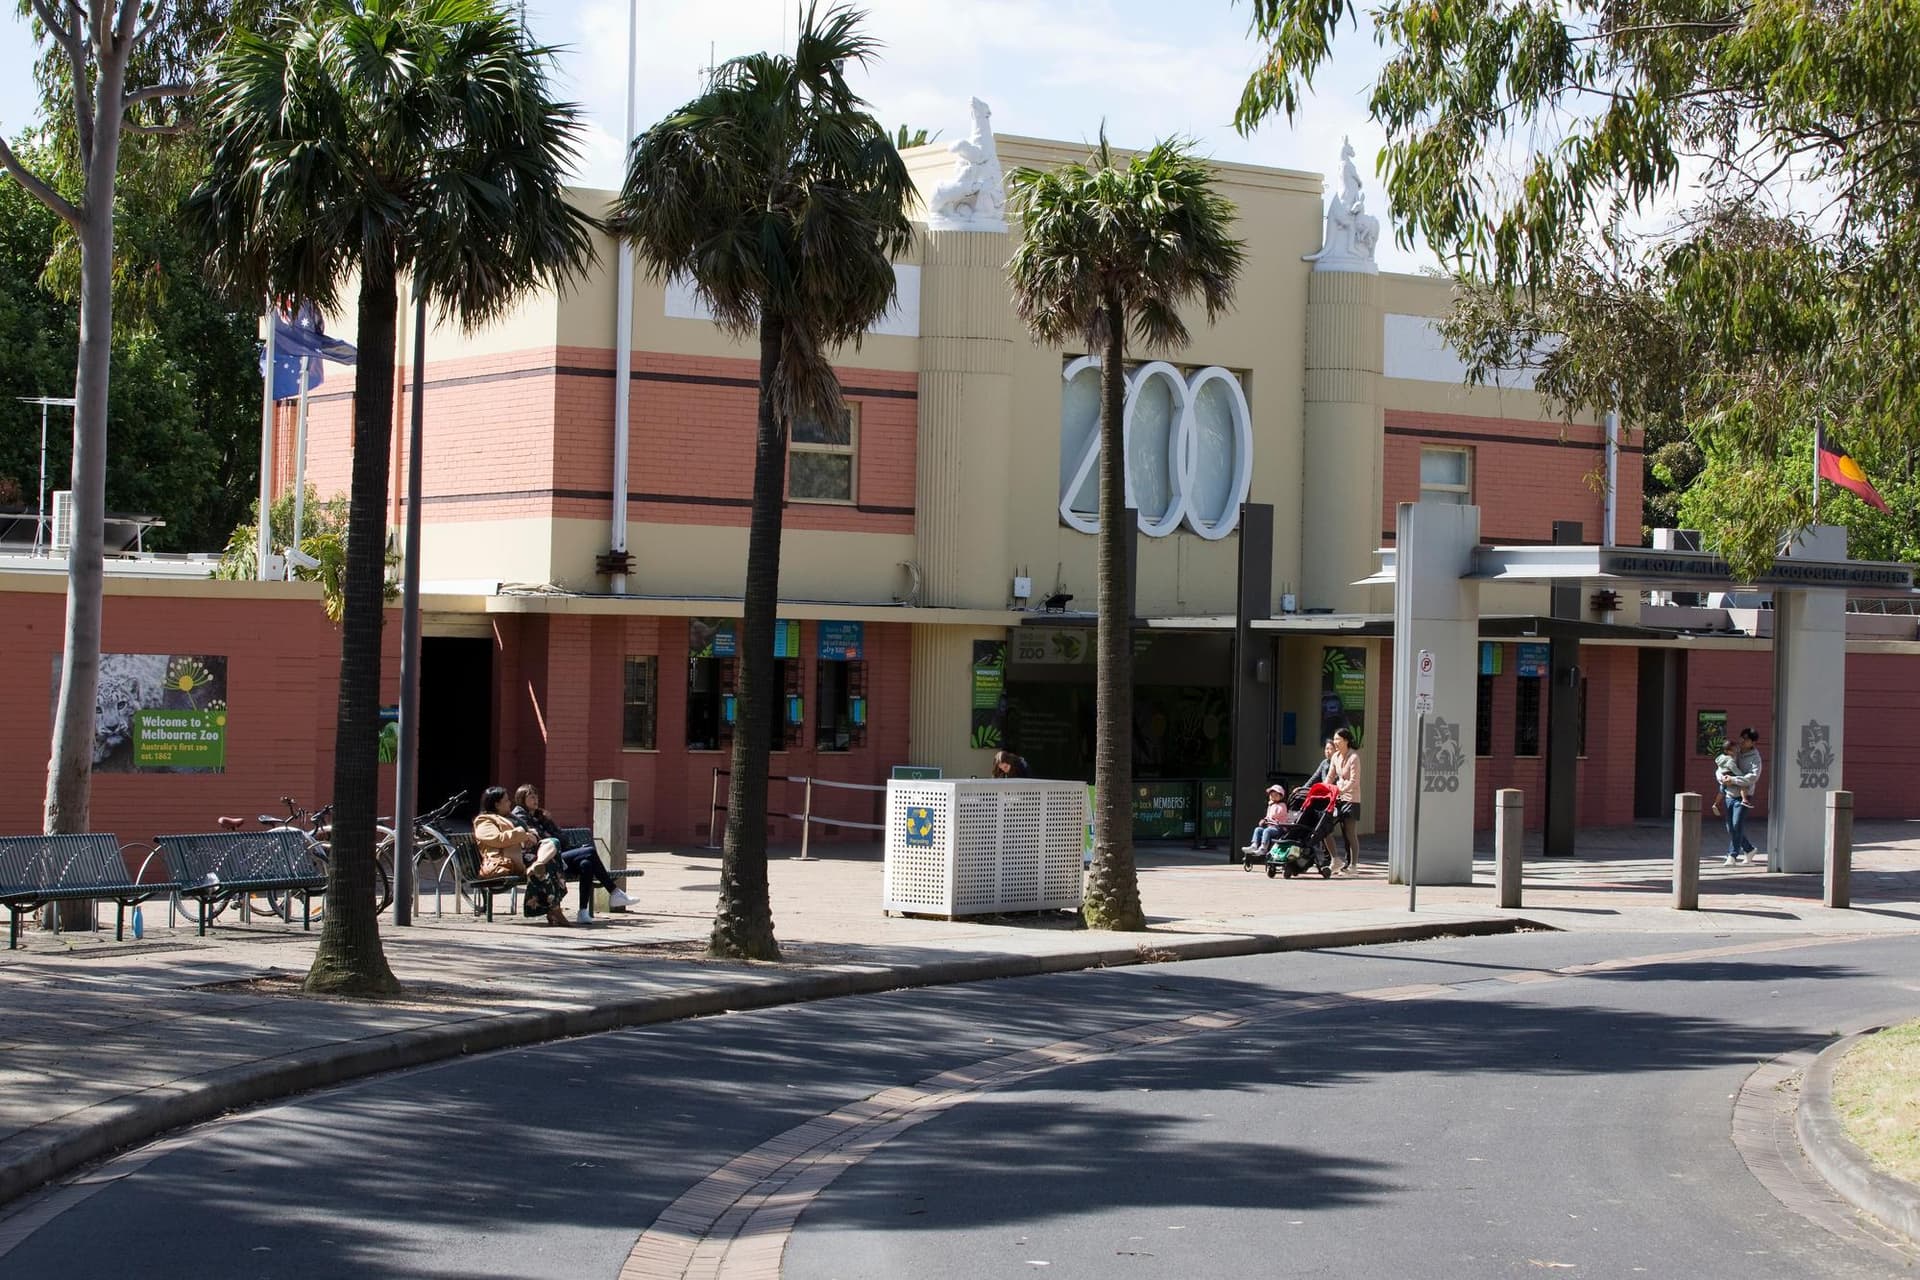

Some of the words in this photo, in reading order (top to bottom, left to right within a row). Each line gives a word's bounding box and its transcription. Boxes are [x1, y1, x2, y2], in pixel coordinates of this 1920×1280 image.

[1019, 648, 1045, 659] ZOO
[142, 715, 188, 727] Welcome
[191, 717, 201, 727] to
[142, 729, 197, 740] Melbourne
[200, 730, 219, 740] Zoo
[141, 743, 177, 751] Australia's
[179, 743, 194, 751] first
[155, 752, 171, 760] 1862
[1424, 775, 1459, 793] ZOO
[1800, 773, 1829, 789] ZOO
